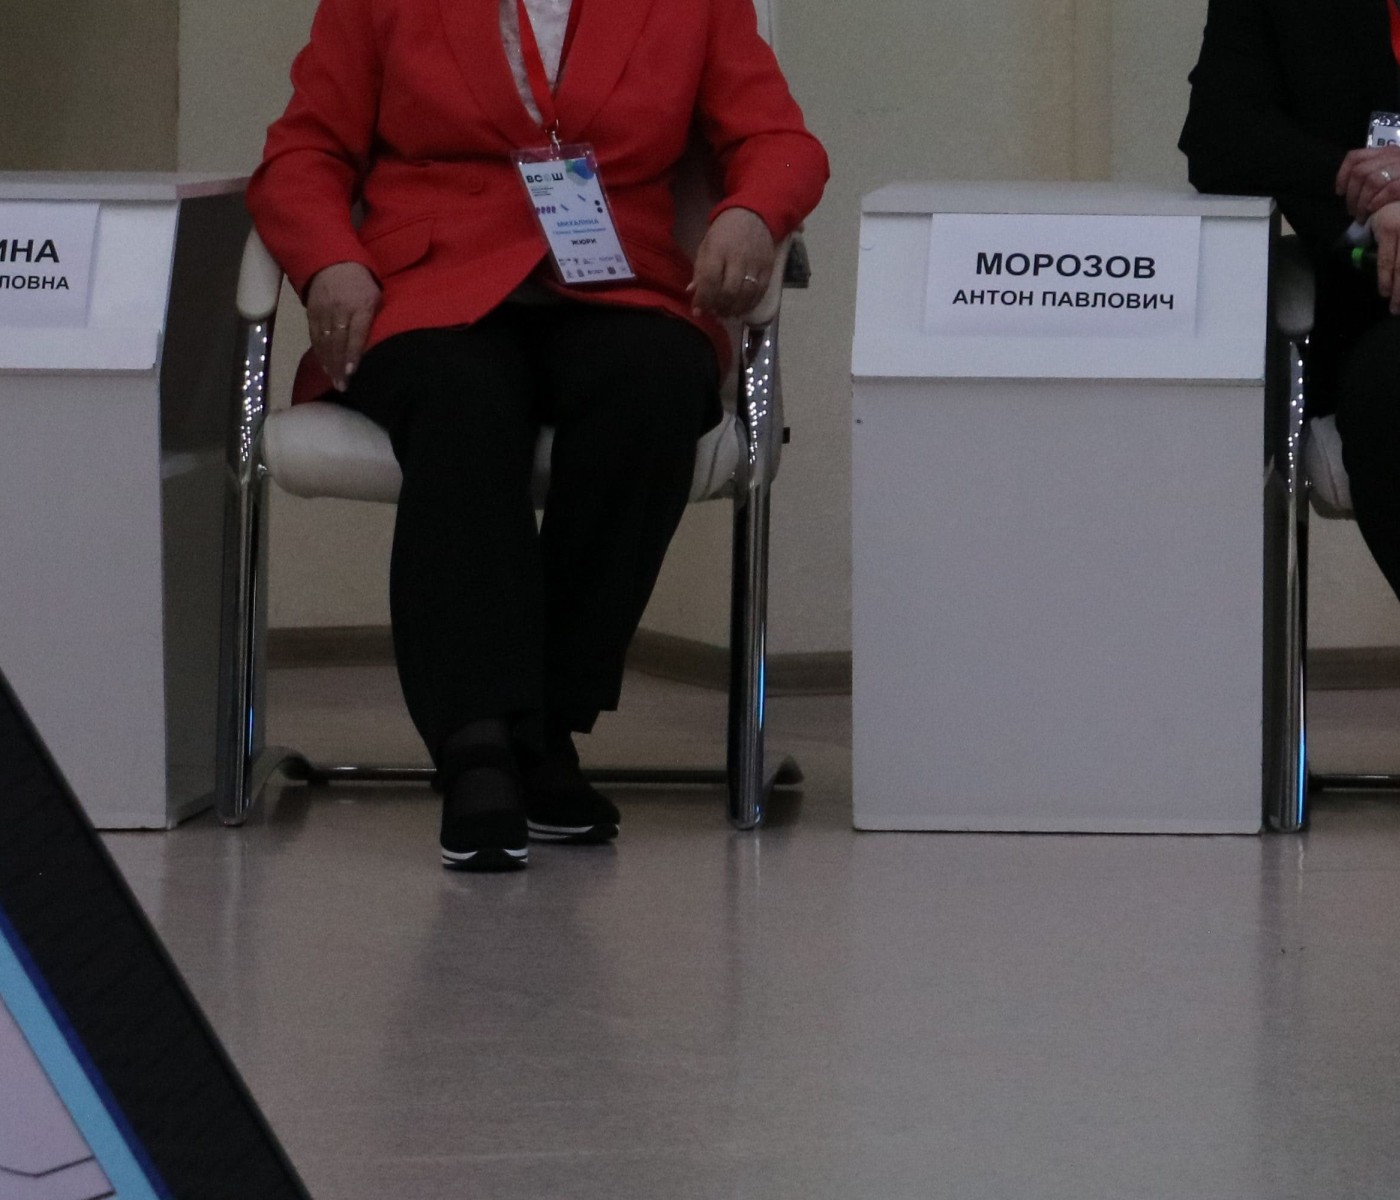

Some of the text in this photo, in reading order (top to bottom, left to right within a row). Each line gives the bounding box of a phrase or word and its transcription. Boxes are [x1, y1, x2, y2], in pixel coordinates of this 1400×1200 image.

[976, 252, 1155, 278] МОРОЗОВ
[953, 290, 1173, 309] АНТОН ПАВЛОВИЧ
